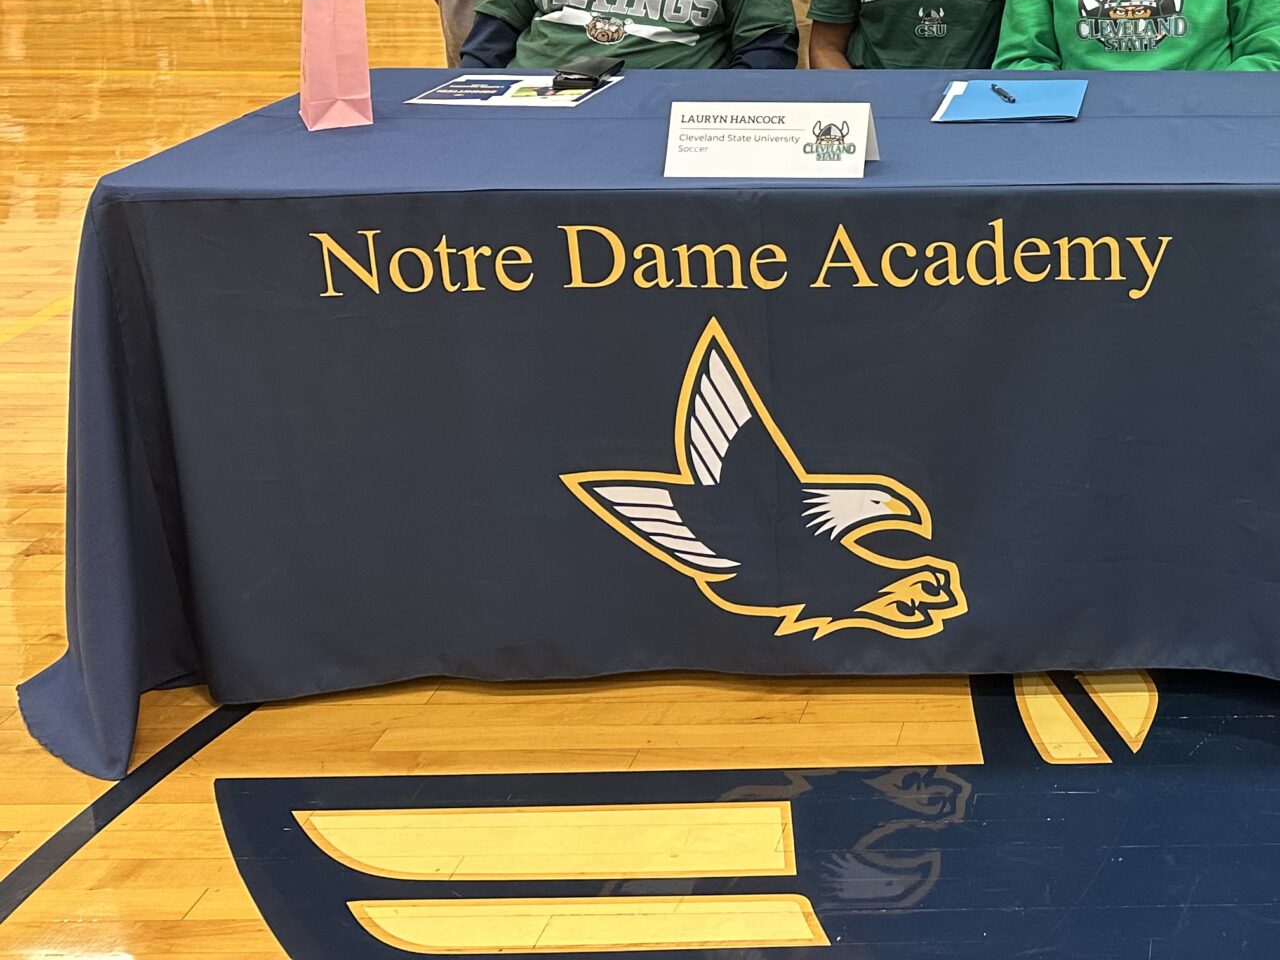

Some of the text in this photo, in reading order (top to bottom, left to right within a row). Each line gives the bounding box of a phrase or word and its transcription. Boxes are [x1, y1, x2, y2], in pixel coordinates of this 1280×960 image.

[915, 24, 947, 37] CSU
[1076, 15, 1189, 40] CLEVELAND
[1104, 37, 1158, 52] STATE
[680, 114, 786, 125] LAURYN HANCOCK
[679, 133, 801, 144] Cleveland State University
[678, 144, 709, 153] Soccer
[803, 142, 857, 155] CLEVELAND
[309, 217, 1173, 300] Notre Dame Academy
